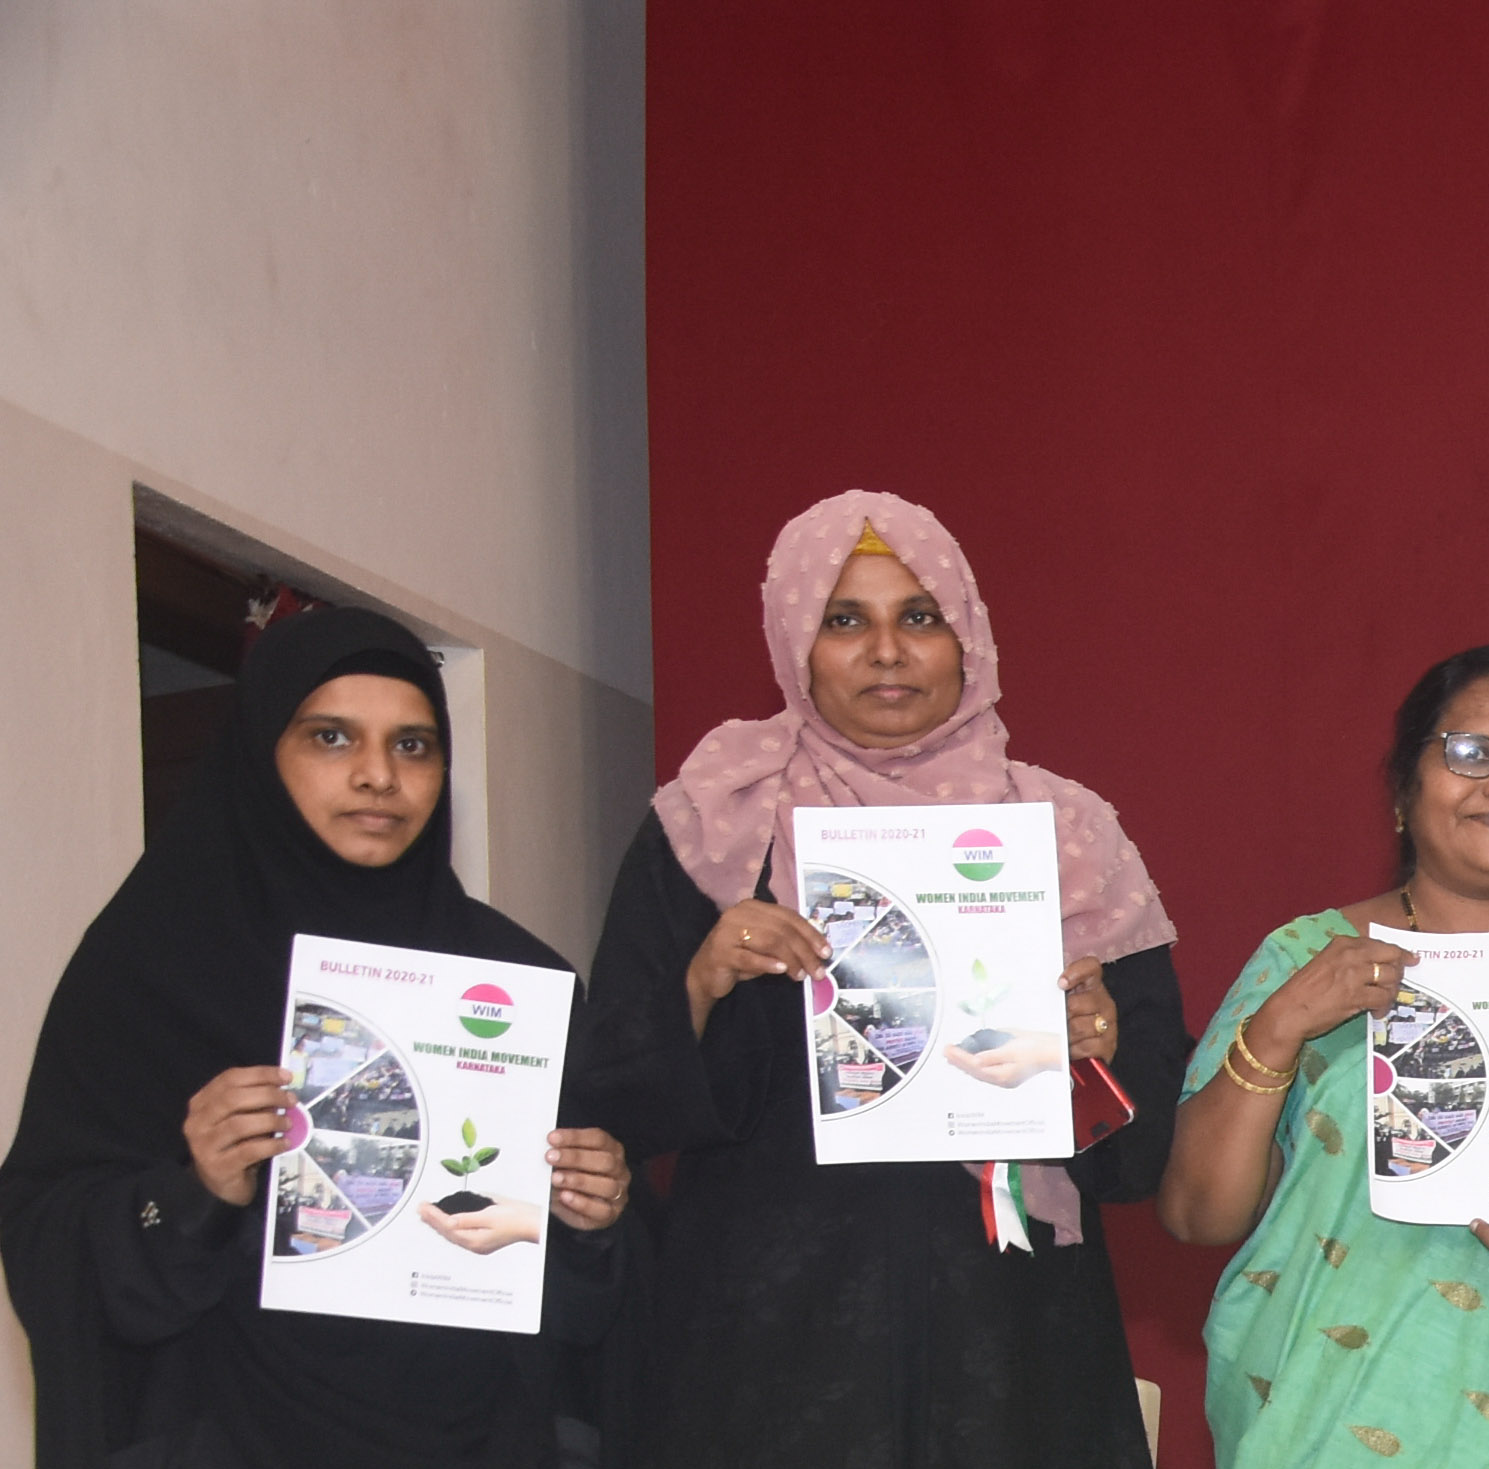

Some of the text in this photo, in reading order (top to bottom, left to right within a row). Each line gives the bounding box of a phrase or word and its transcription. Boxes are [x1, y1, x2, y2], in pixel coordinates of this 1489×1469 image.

[881, 829, 925, 840] 2020-21
[964, 850, 993, 860] WIM
[916, 891, 1045, 903] WOMEN INDIA MOVEMENT
[1444, 950, 1483, 959] 2020-21
[320, 960, 434, 984] BULLETIN 2020-21
[472, 1004, 502, 1018] WIM
[414, 1041, 549, 1069] WOMEN INDIA MOVEMENT
